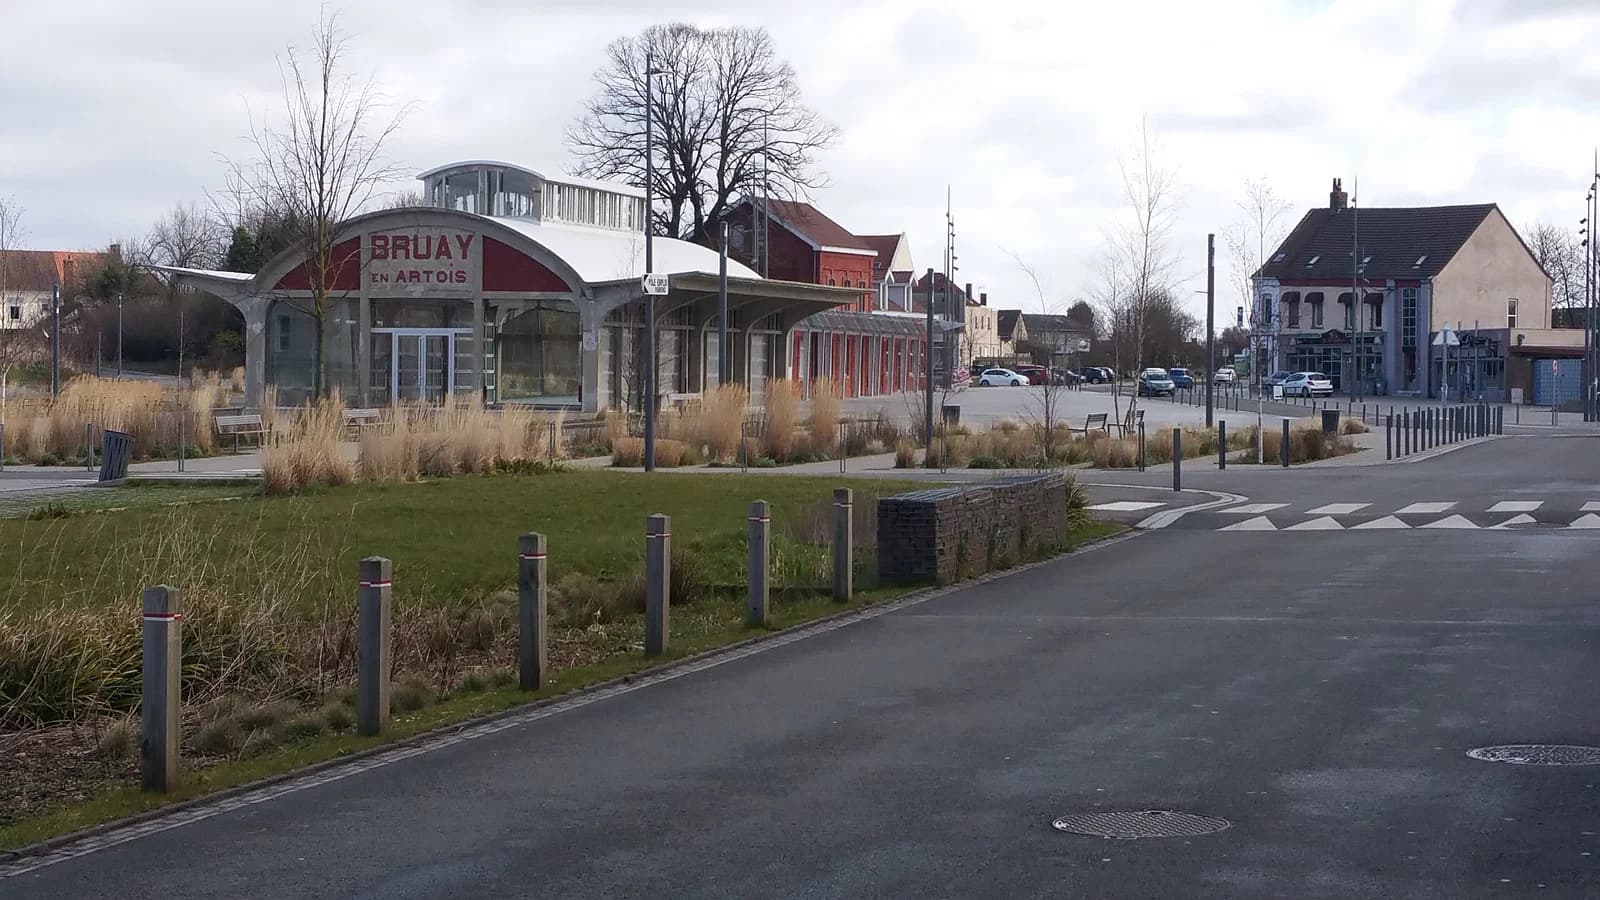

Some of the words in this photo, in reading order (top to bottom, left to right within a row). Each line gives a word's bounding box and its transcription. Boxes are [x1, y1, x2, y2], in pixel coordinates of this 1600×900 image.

[371, 235, 473, 260] BRUAY
[371, 273, 389, 283] EN
[396, 263, 467, 283] ARTOIS
